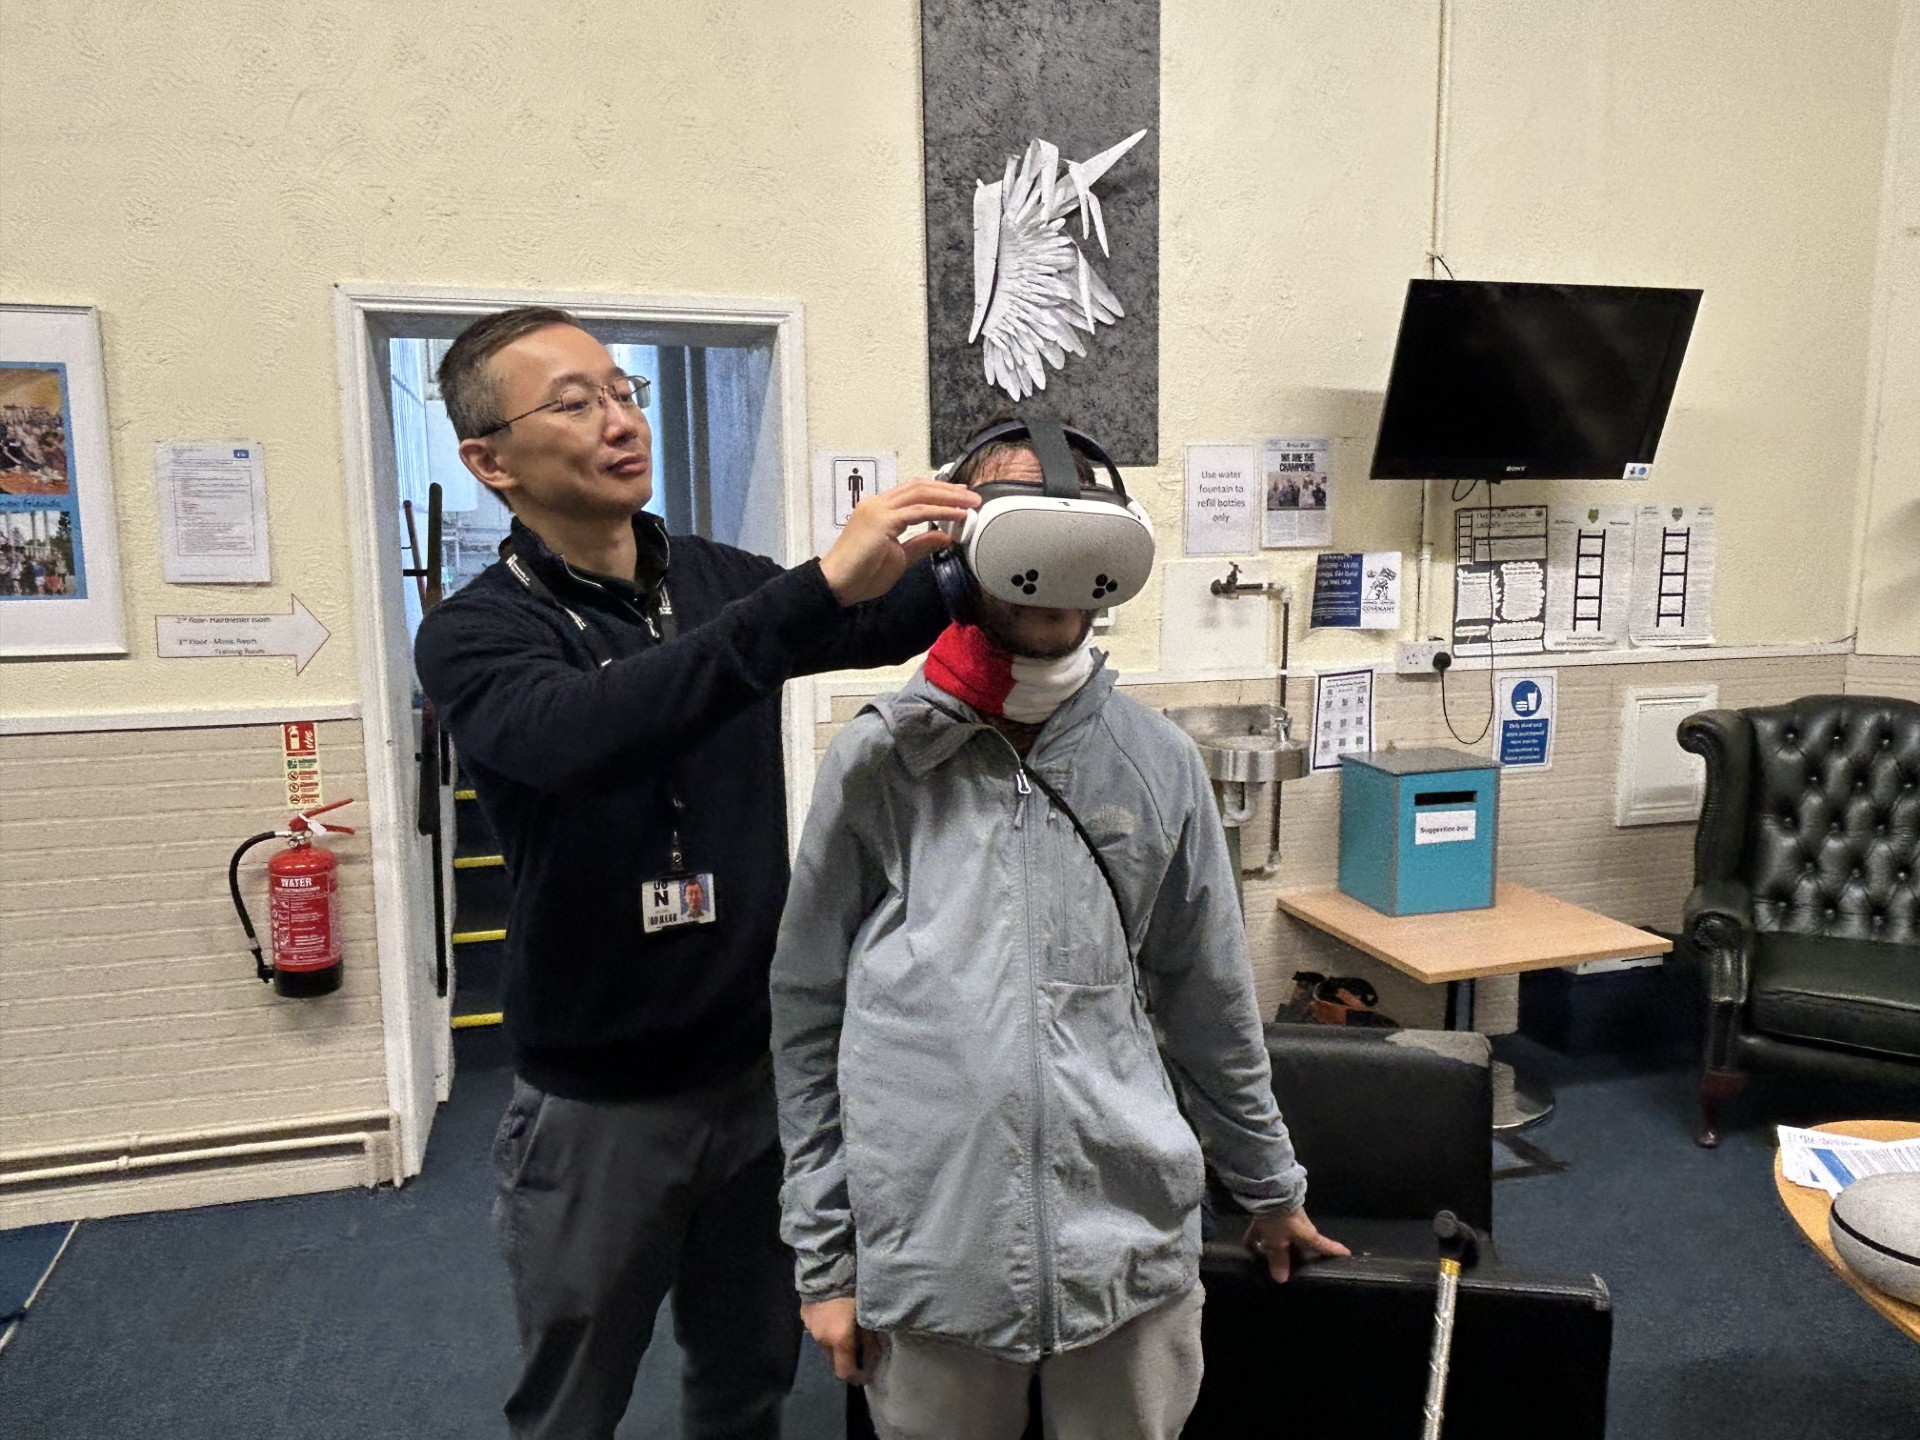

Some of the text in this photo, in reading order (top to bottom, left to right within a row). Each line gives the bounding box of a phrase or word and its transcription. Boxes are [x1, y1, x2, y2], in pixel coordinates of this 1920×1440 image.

[1218, 471, 1241, 479] water
[1199, 485, 1234, 493] fountain
[1197, 499, 1246, 508] refill bottles
[1212, 513, 1230, 523] only
[281, 877, 313, 888] WATER
